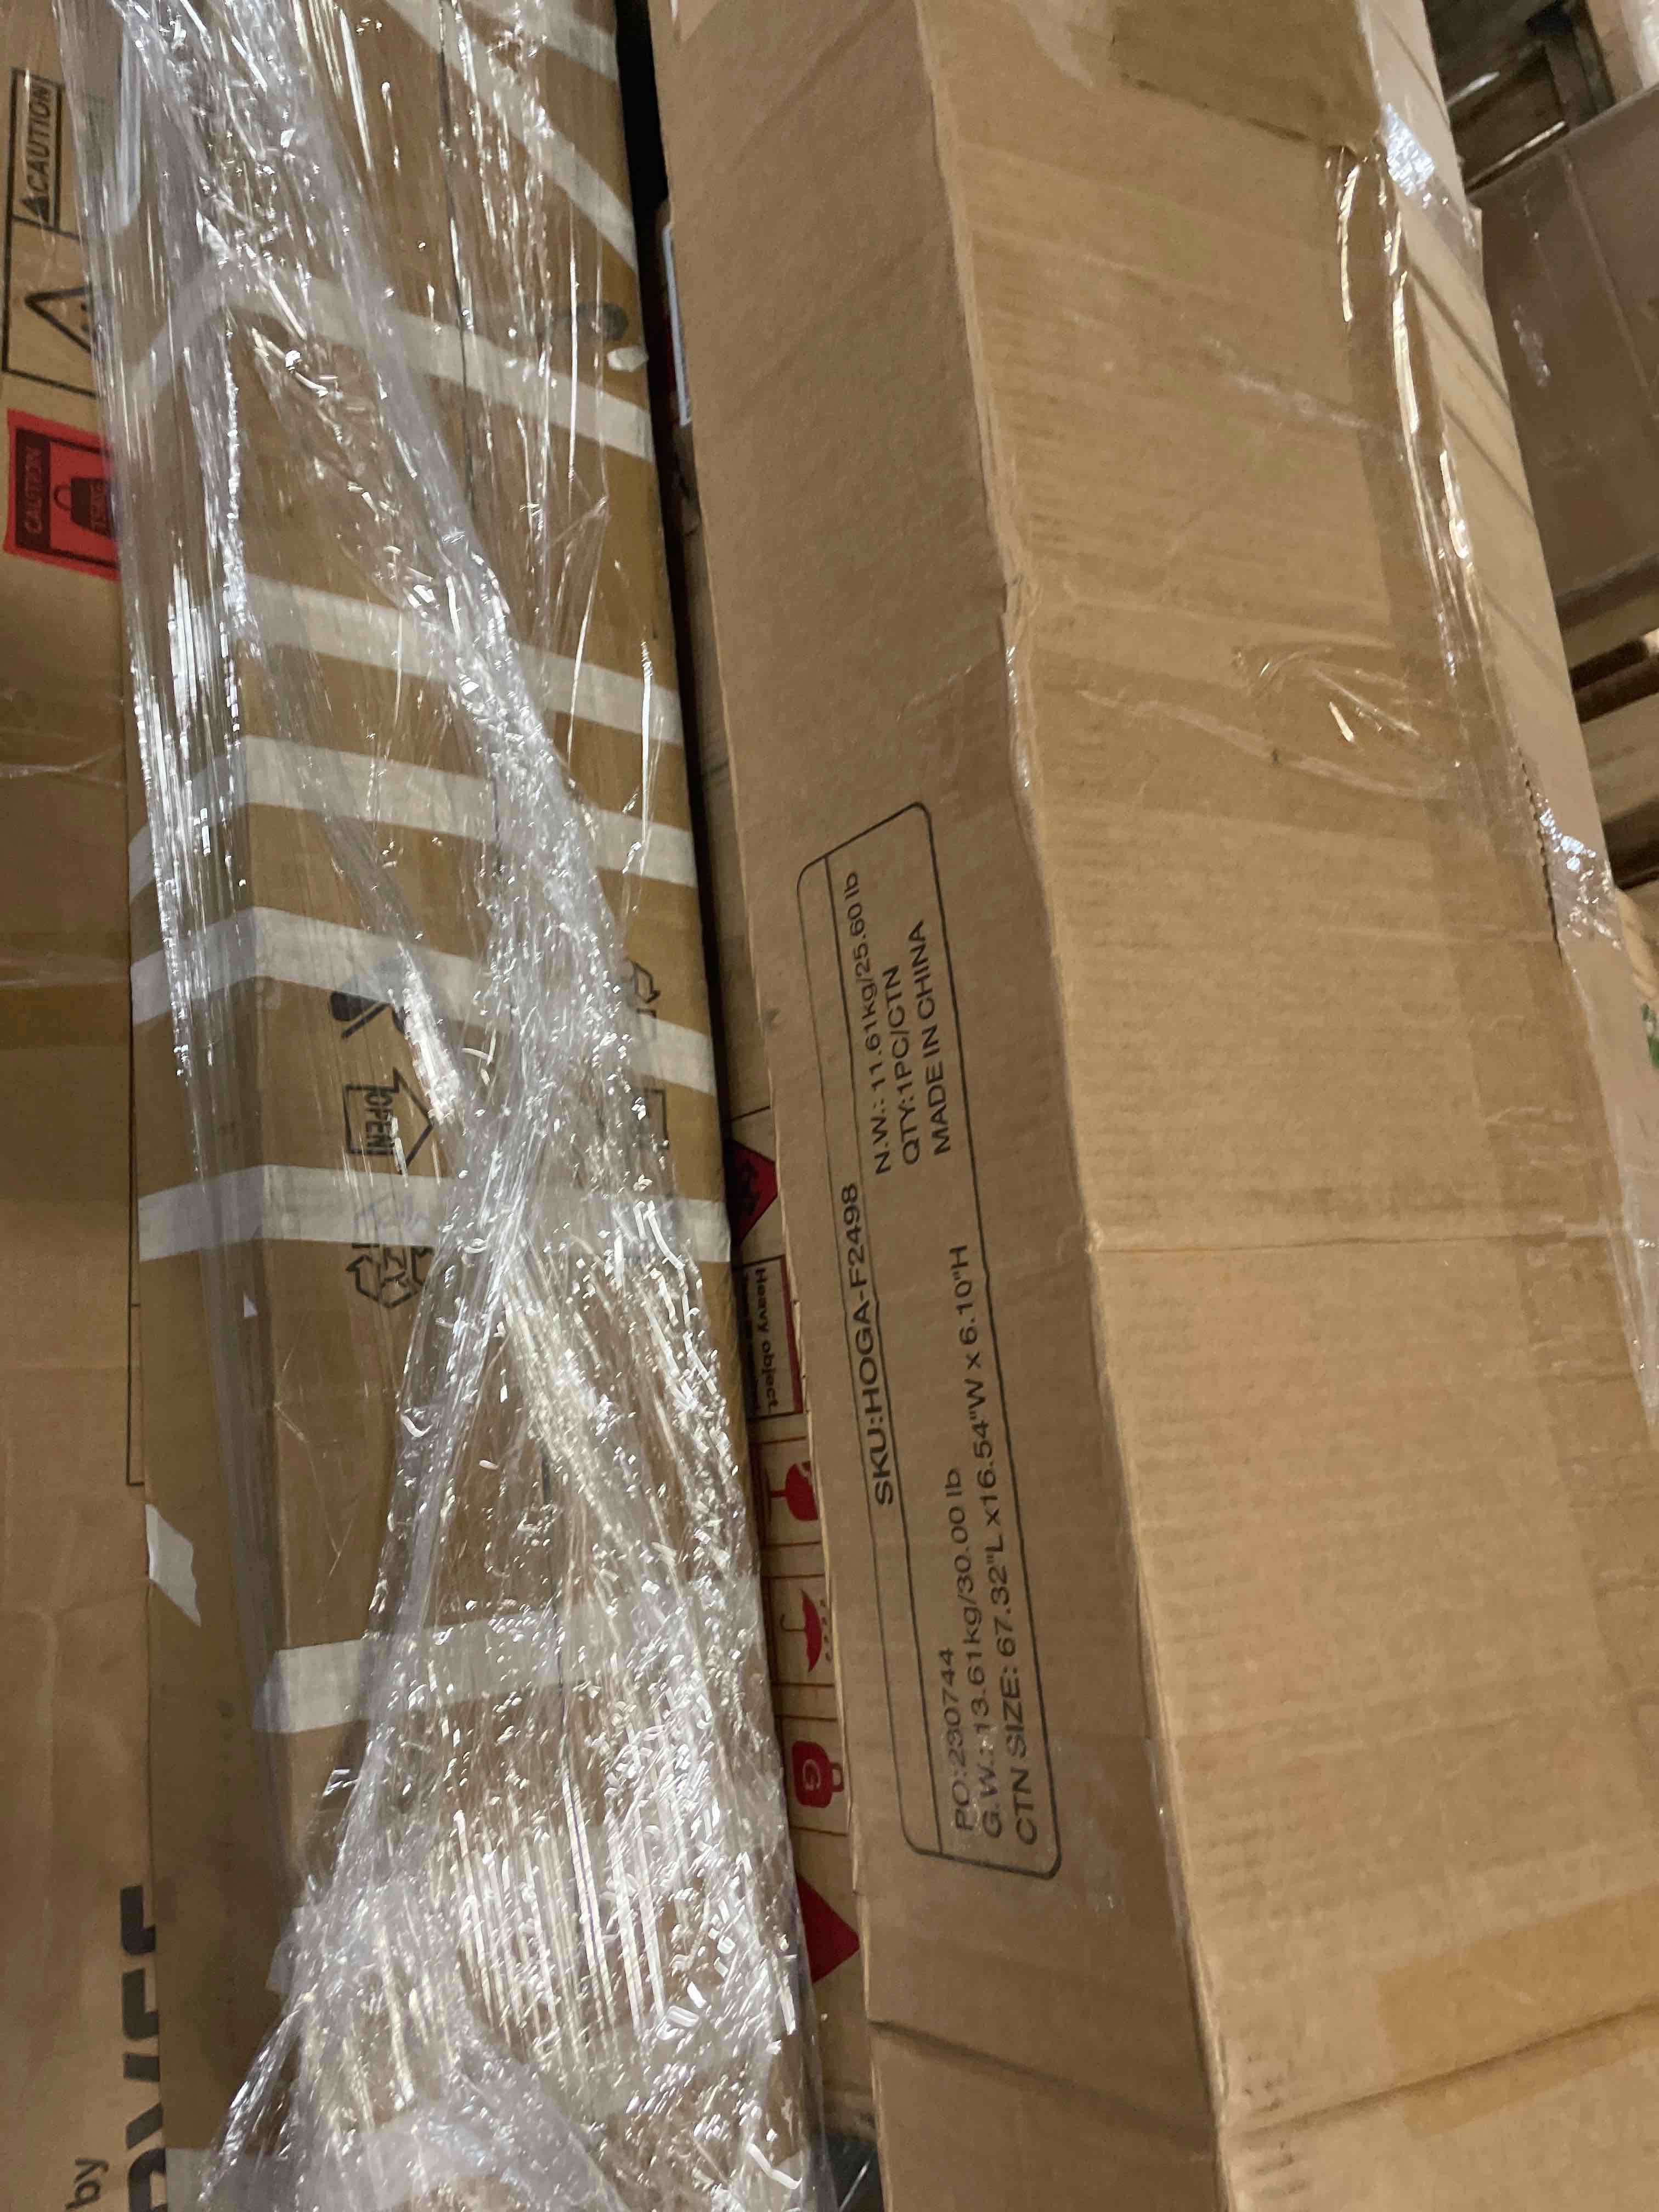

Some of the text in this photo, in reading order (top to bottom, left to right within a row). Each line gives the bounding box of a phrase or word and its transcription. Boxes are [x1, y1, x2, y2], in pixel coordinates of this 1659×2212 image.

[27, 86, 51, 192] CAUTION
[844, 872, 860, 901] lb
[848, 902, 885, 1092] 11.61kg/25.60
[909, 919, 951, 1155] MADE IN CHINA
[882, 964, 921, 1165] QTY:1PC/CTN
[755, 1268, 779, 1413] Heavy object
[841, 1182, 893, 1506] SKU:HOGA-F2498
[949, 1245, 978, 1345] 6.10"H
[967, 1351, 981, 1370] x
[945, 1469, 962, 1497] lb
[949, 1506, 990, 1734] 13.61kg/30.00
[985, 1533, 1015, 1657] 67.32"L
[939, 1647, 974, 1831] PO:230744
[1000, 1666, 1026, 1758] SIZE:
[1011, 1767, 1037, 1846] CTN
[65, 2157, 109, 2211] by
